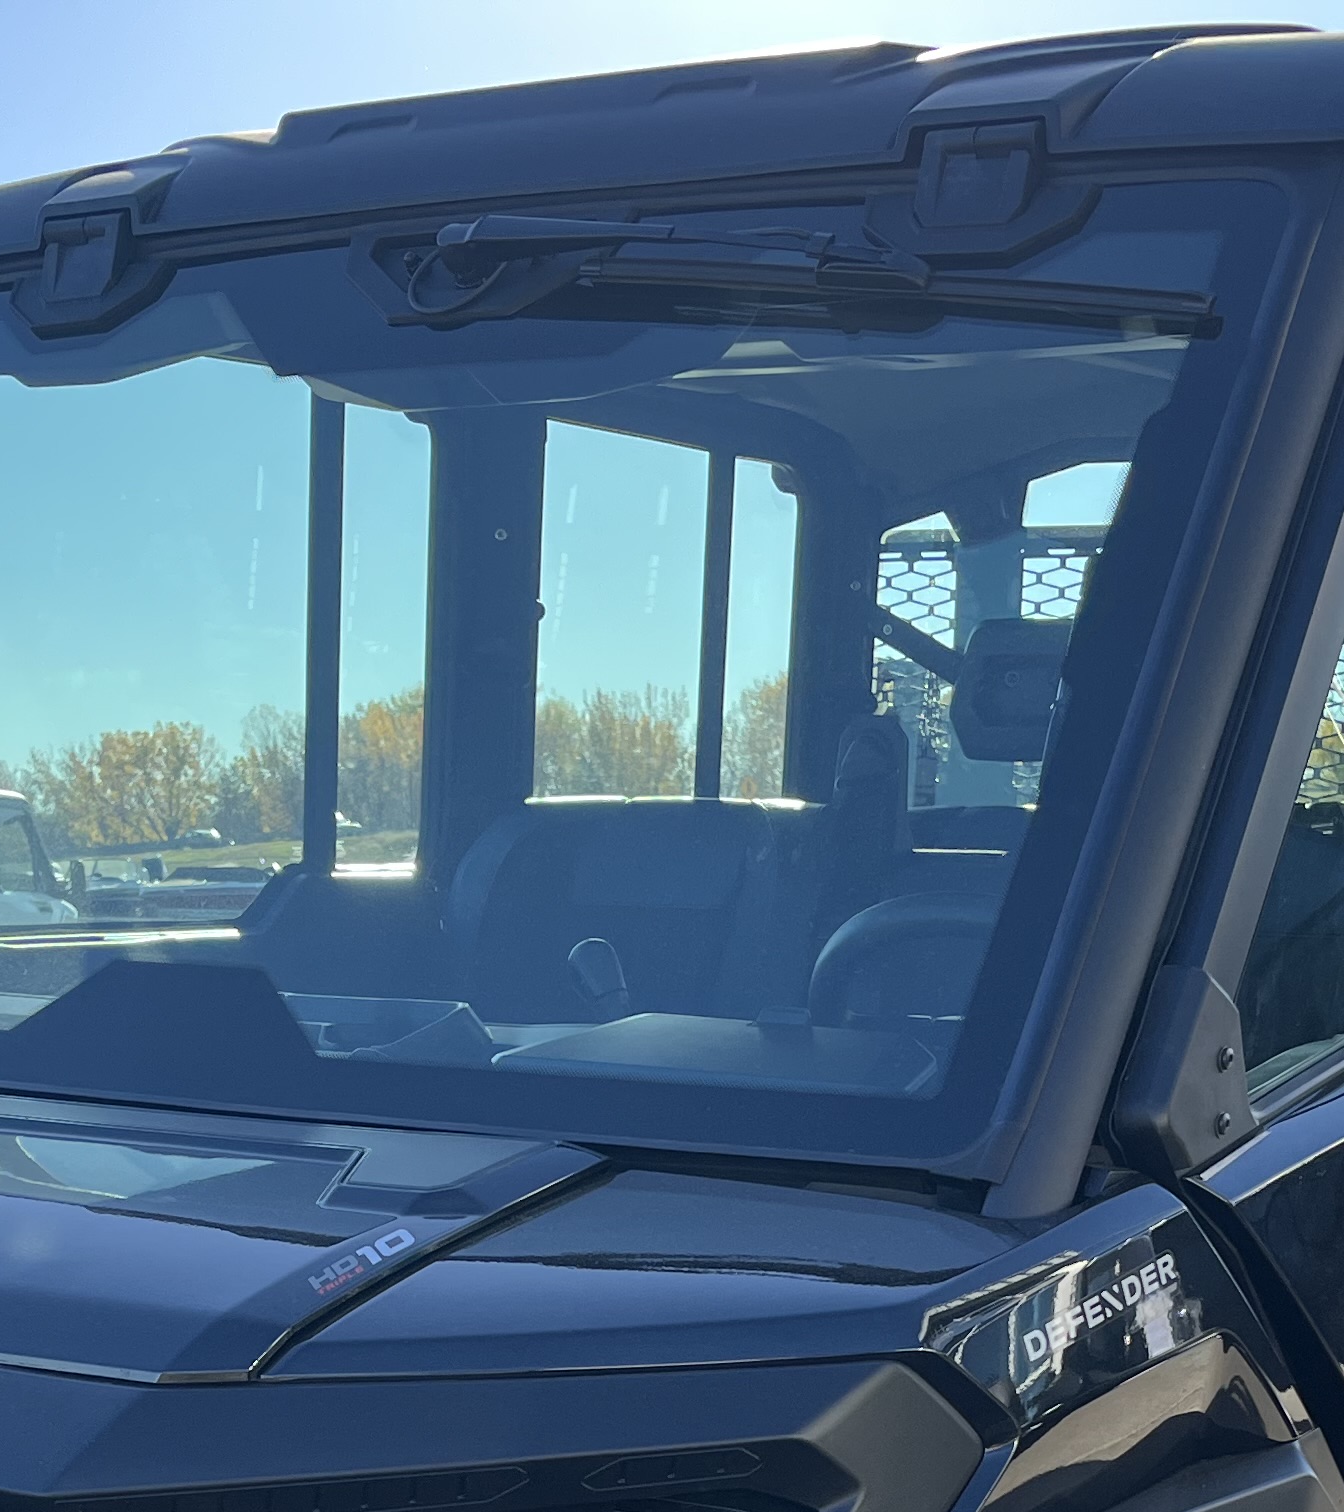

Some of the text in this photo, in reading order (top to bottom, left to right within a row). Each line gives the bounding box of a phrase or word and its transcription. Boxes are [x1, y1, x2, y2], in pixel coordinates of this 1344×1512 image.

[307, 1228, 416, 1291] HD10
[317, 1265, 365, 1296] TRIPLE
[1022, 1253, 1177, 1362] DEFENDER
